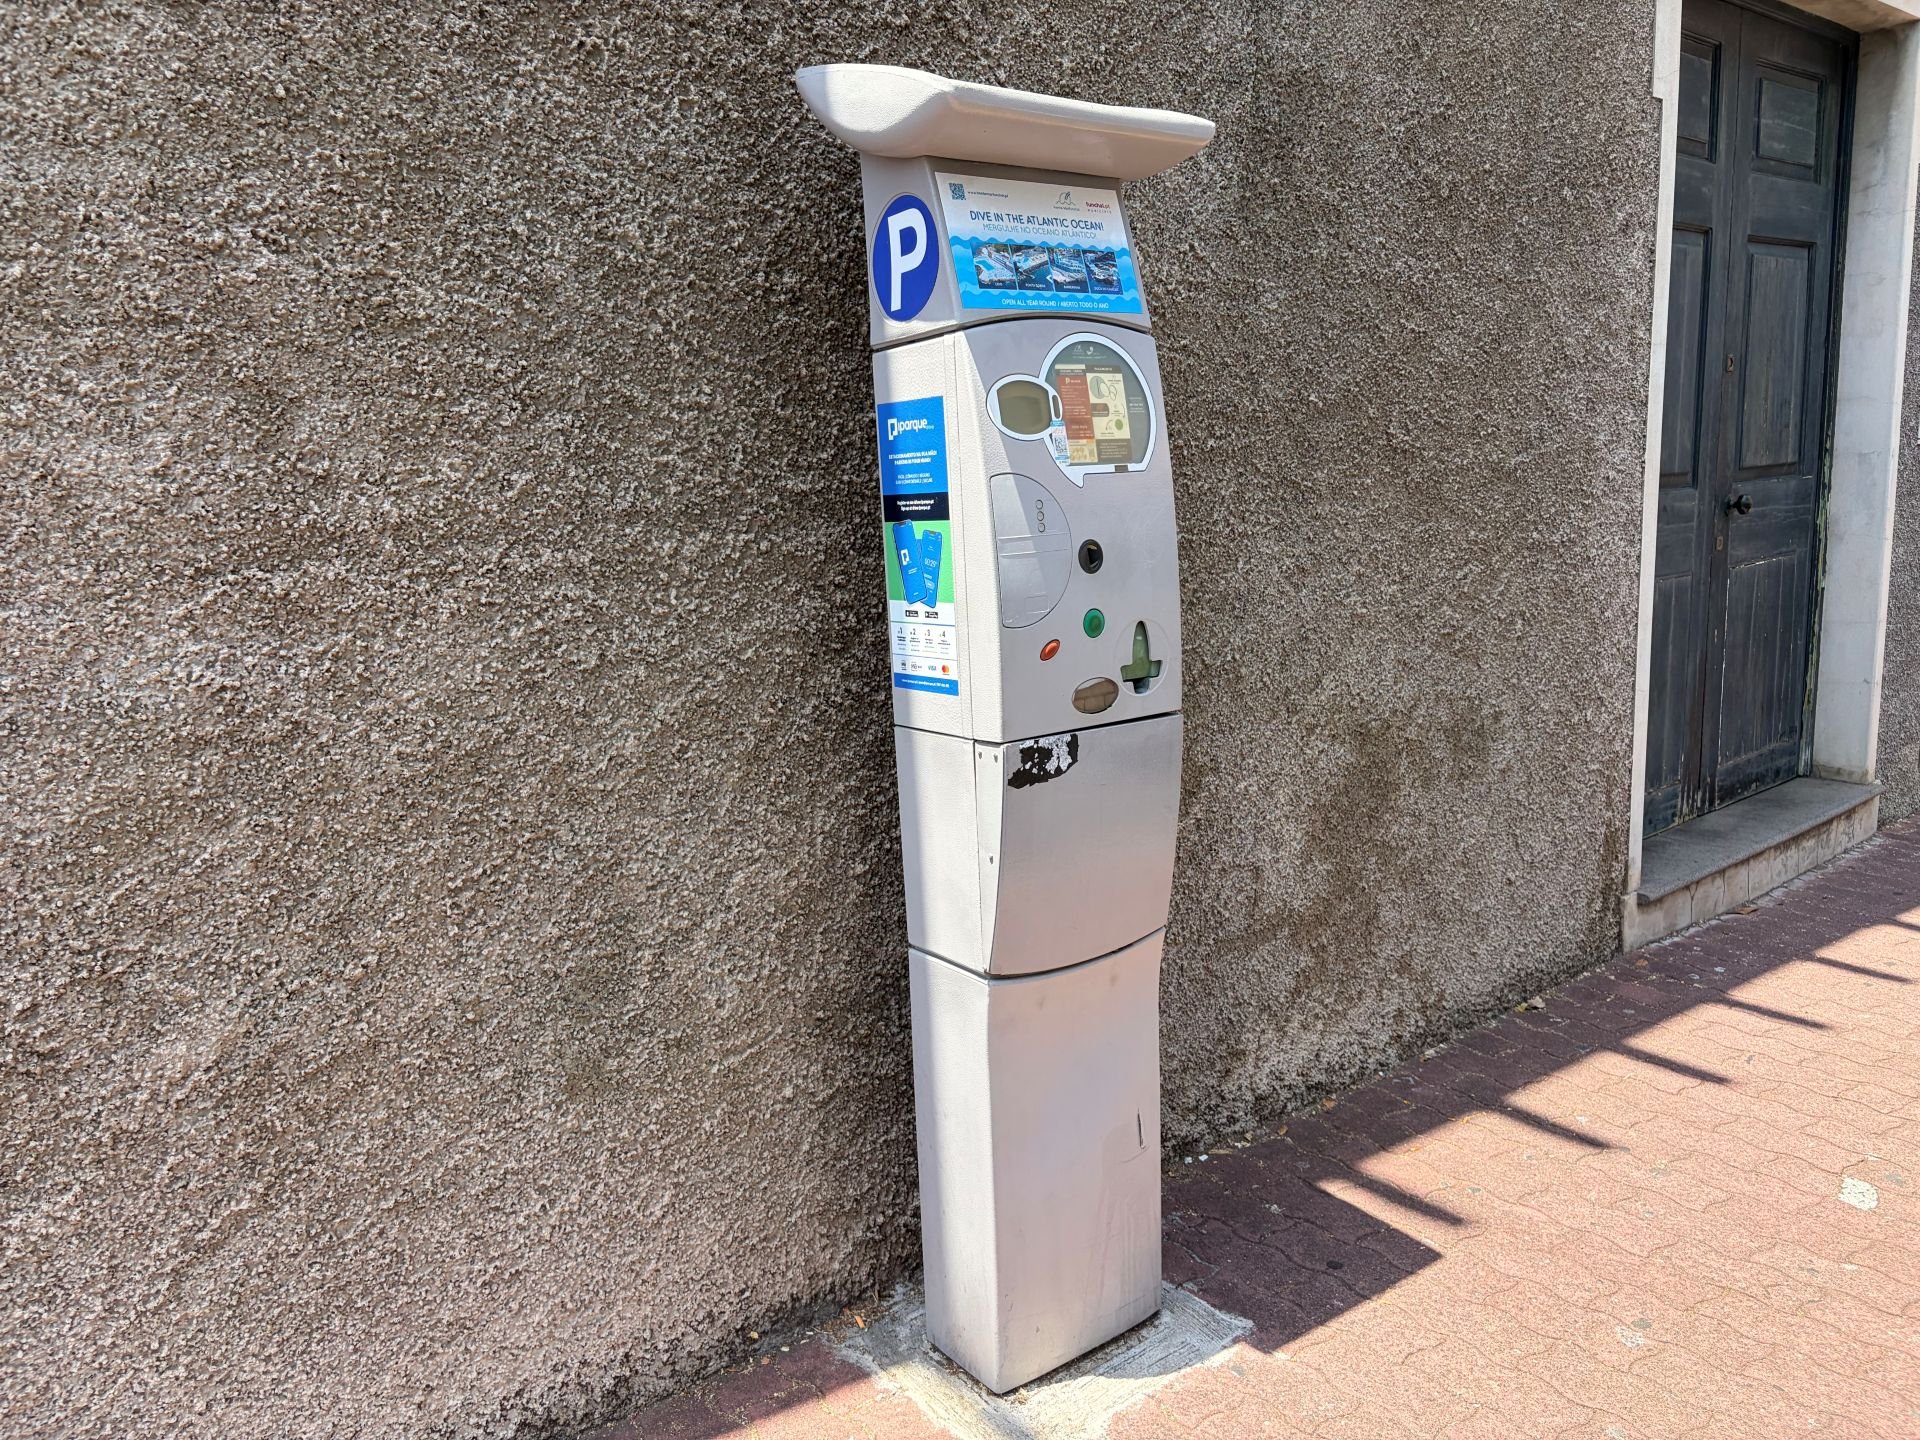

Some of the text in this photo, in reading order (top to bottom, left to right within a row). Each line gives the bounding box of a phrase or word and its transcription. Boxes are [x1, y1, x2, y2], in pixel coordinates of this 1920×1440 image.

[970, 210, 1104, 231] DIVE IN THE ATLANTIC OCEAN!
[983, 223, 1019, 233] MERGULHE
[1032, 227, 1060, 236] OCEANO
[888, 208, 927, 312] P
